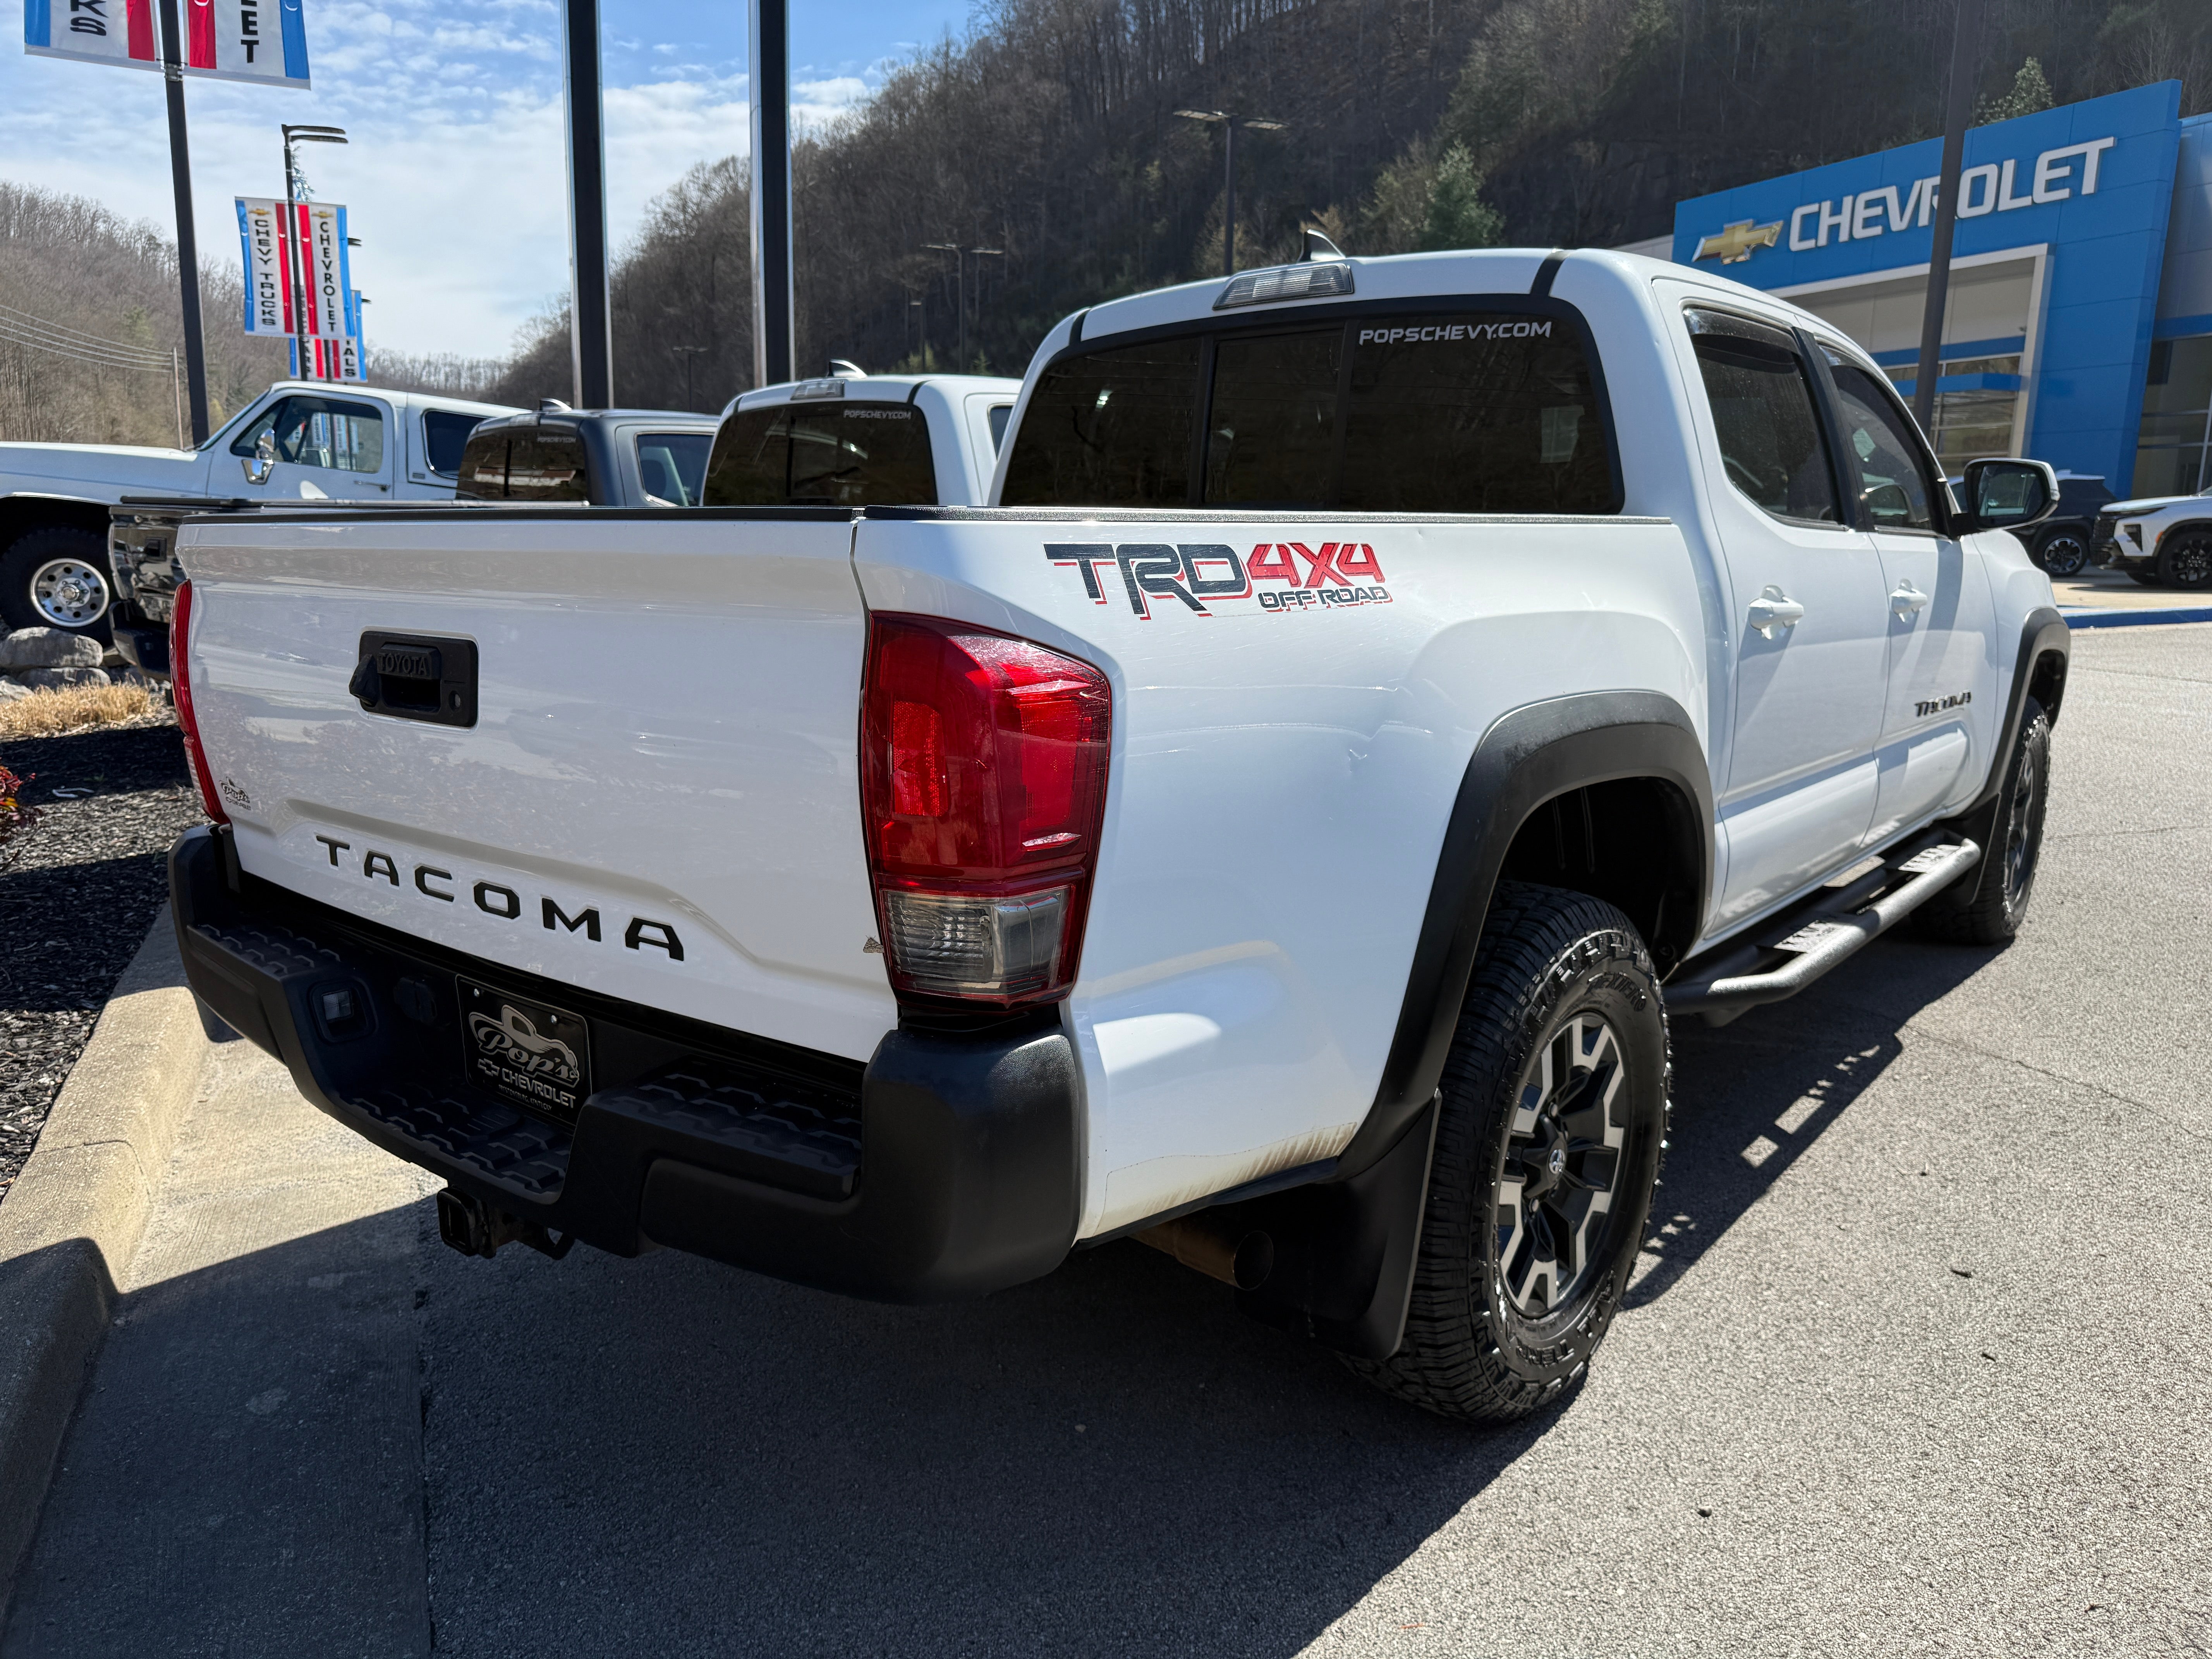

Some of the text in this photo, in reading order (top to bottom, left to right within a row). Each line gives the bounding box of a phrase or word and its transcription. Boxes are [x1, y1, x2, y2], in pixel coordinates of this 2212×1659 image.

[240, 0, 259, 64] ET
[255, 220, 276, 326] CHEVY TRUCKS
[320, 222, 336, 332] CHEVROLET
[1359, 322, 1551, 345] POPSCHEVY.COM
[843, 409, 912, 419] POPSCHEVY.COM
[1044, 544, 1252, 620] TRD
[1258, 586, 1393, 612] OFF ROAD
[378, 653, 427, 675] TOYOTA
[1915, 690, 1971, 716] TACOMA
[315, 834, 684, 962] TACOMA
[478, 1027, 570, 1080] Pop's
[502, 1068, 576, 1109] CHEVROLET
[530, 1097, 552, 1111] KENTUCKY
